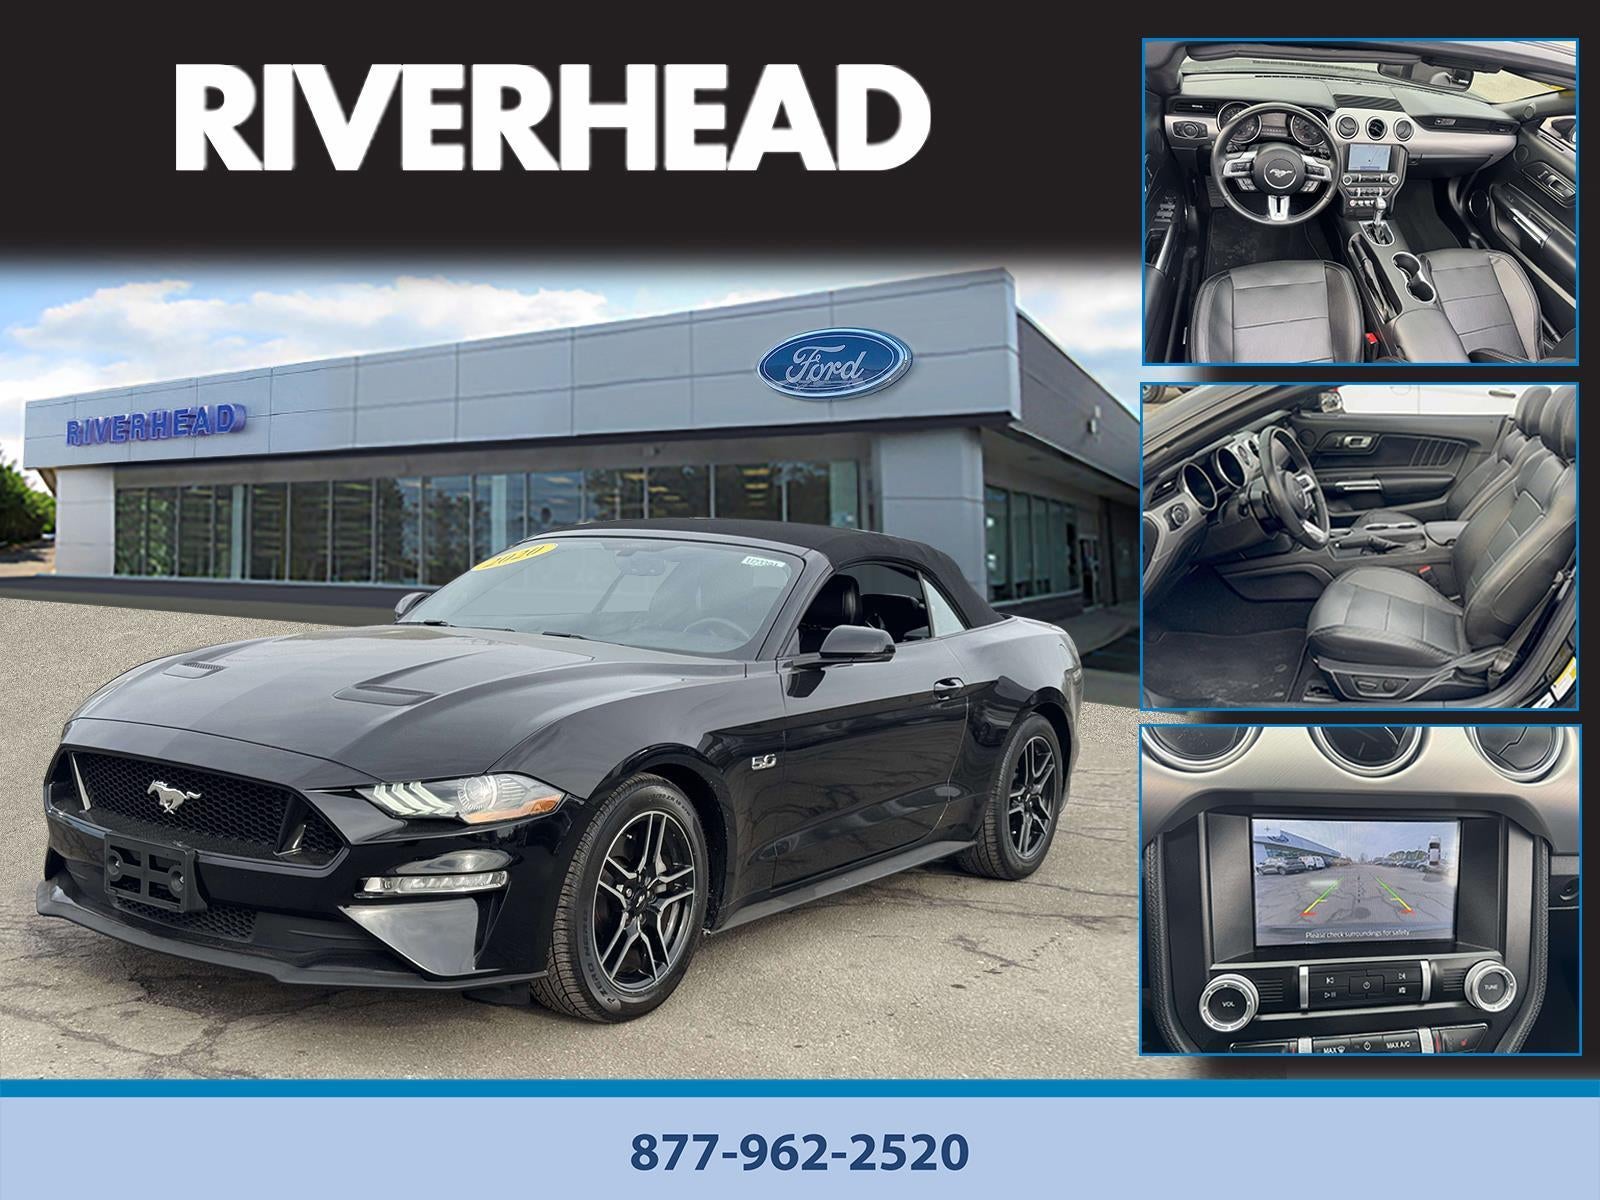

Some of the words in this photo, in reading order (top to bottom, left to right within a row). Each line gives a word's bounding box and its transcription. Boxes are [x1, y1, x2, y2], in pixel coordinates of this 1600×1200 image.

[785, 344, 867, 384] Ford
[66, 402, 248, 446] RIVERHEAD
[481, 545, 536, 569] 2020
[752, 753, 777, 771] 5.0
[1305, 931, 1326, 939] Please
[1327, 930, 1344, 938] check
[1345, 930, 1382, 938] surroundings
[1483, 983, 1499, 991] TUNE
[1221, 1000, 1236, 1008] VOL
[1386, 1041, 1400, 1049] MAX
[1400, 1040, 1411, 1048] A/C
